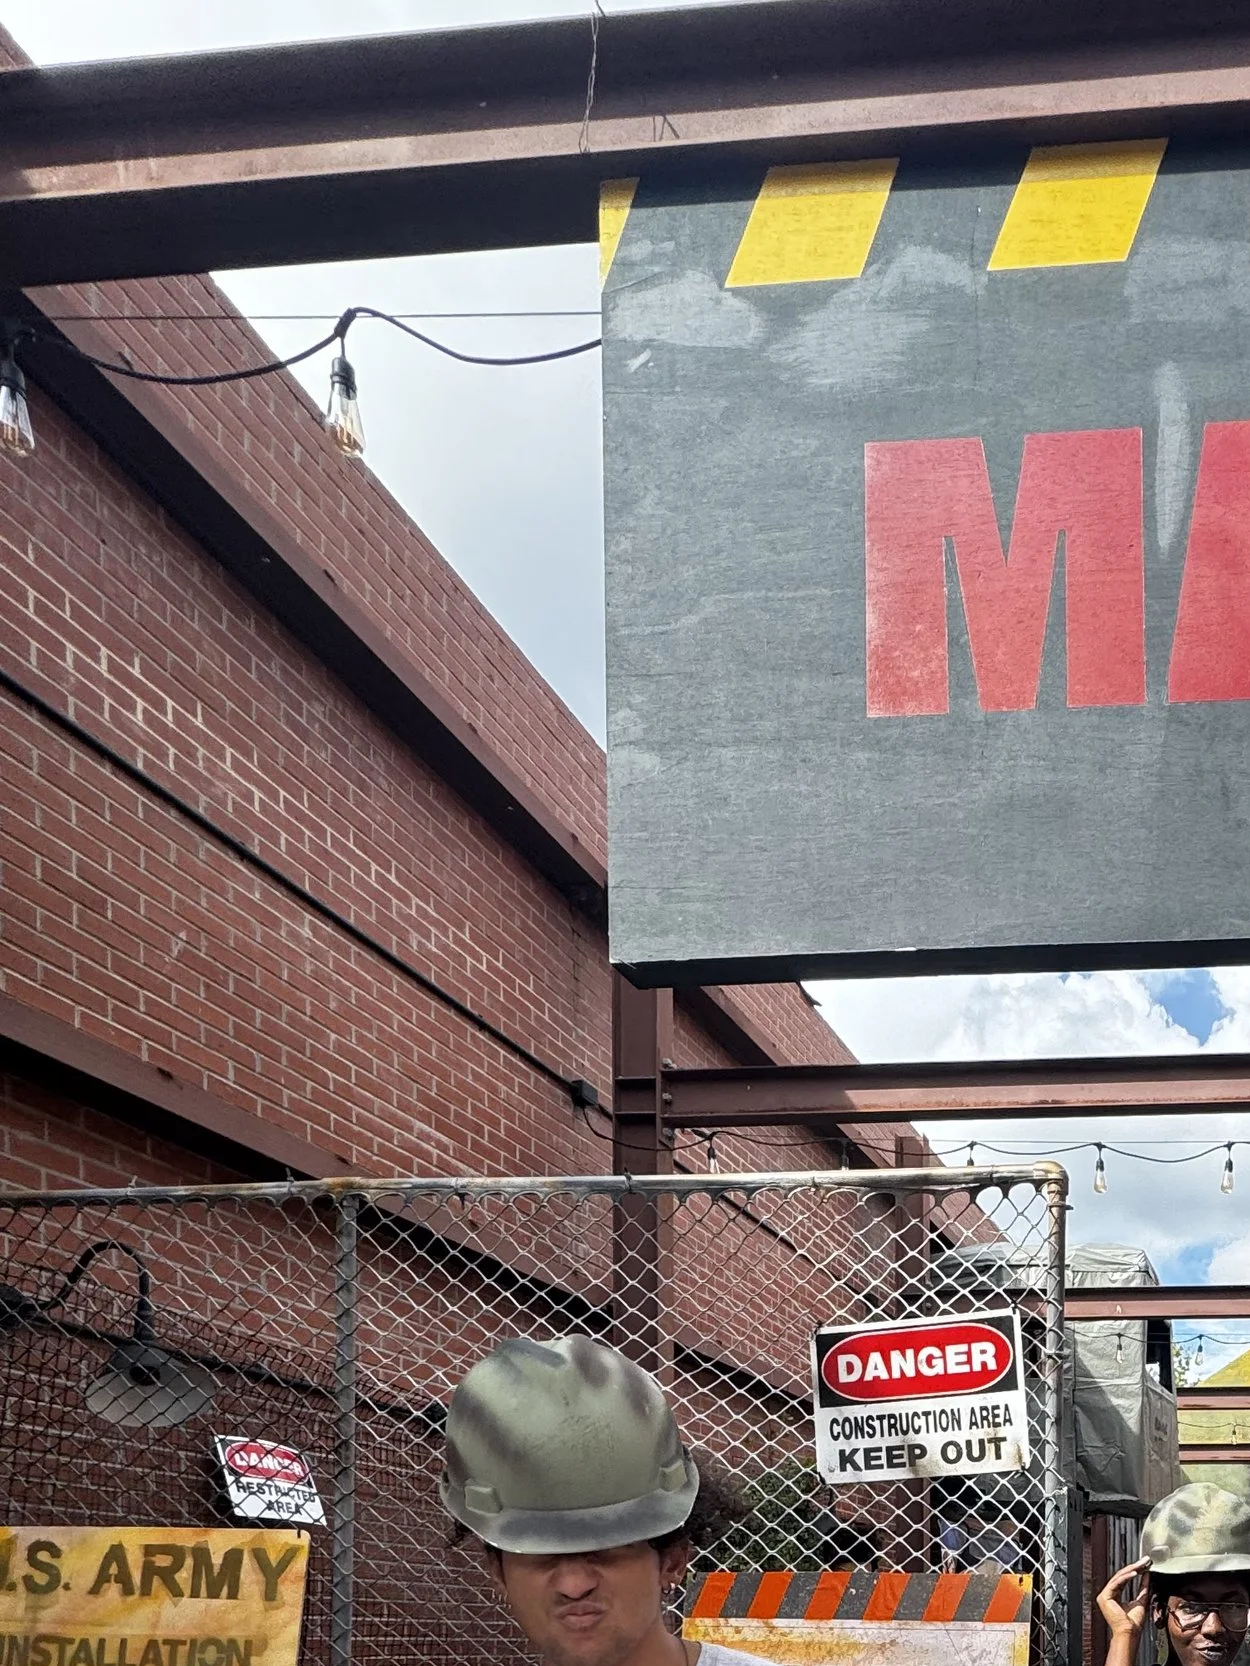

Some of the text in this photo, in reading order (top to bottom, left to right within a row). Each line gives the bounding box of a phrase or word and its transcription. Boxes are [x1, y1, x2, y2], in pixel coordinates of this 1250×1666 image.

[836, 1341, 998, 1383] DANGER
[829, 1403, 1014, 1441] CONSTRUCTION AREA
[838, 1436, 1007, 1472] KEEP OUT
[266, 1500, 302, 1515] AREA
[87, 1539, 299, 1601] ARMY
